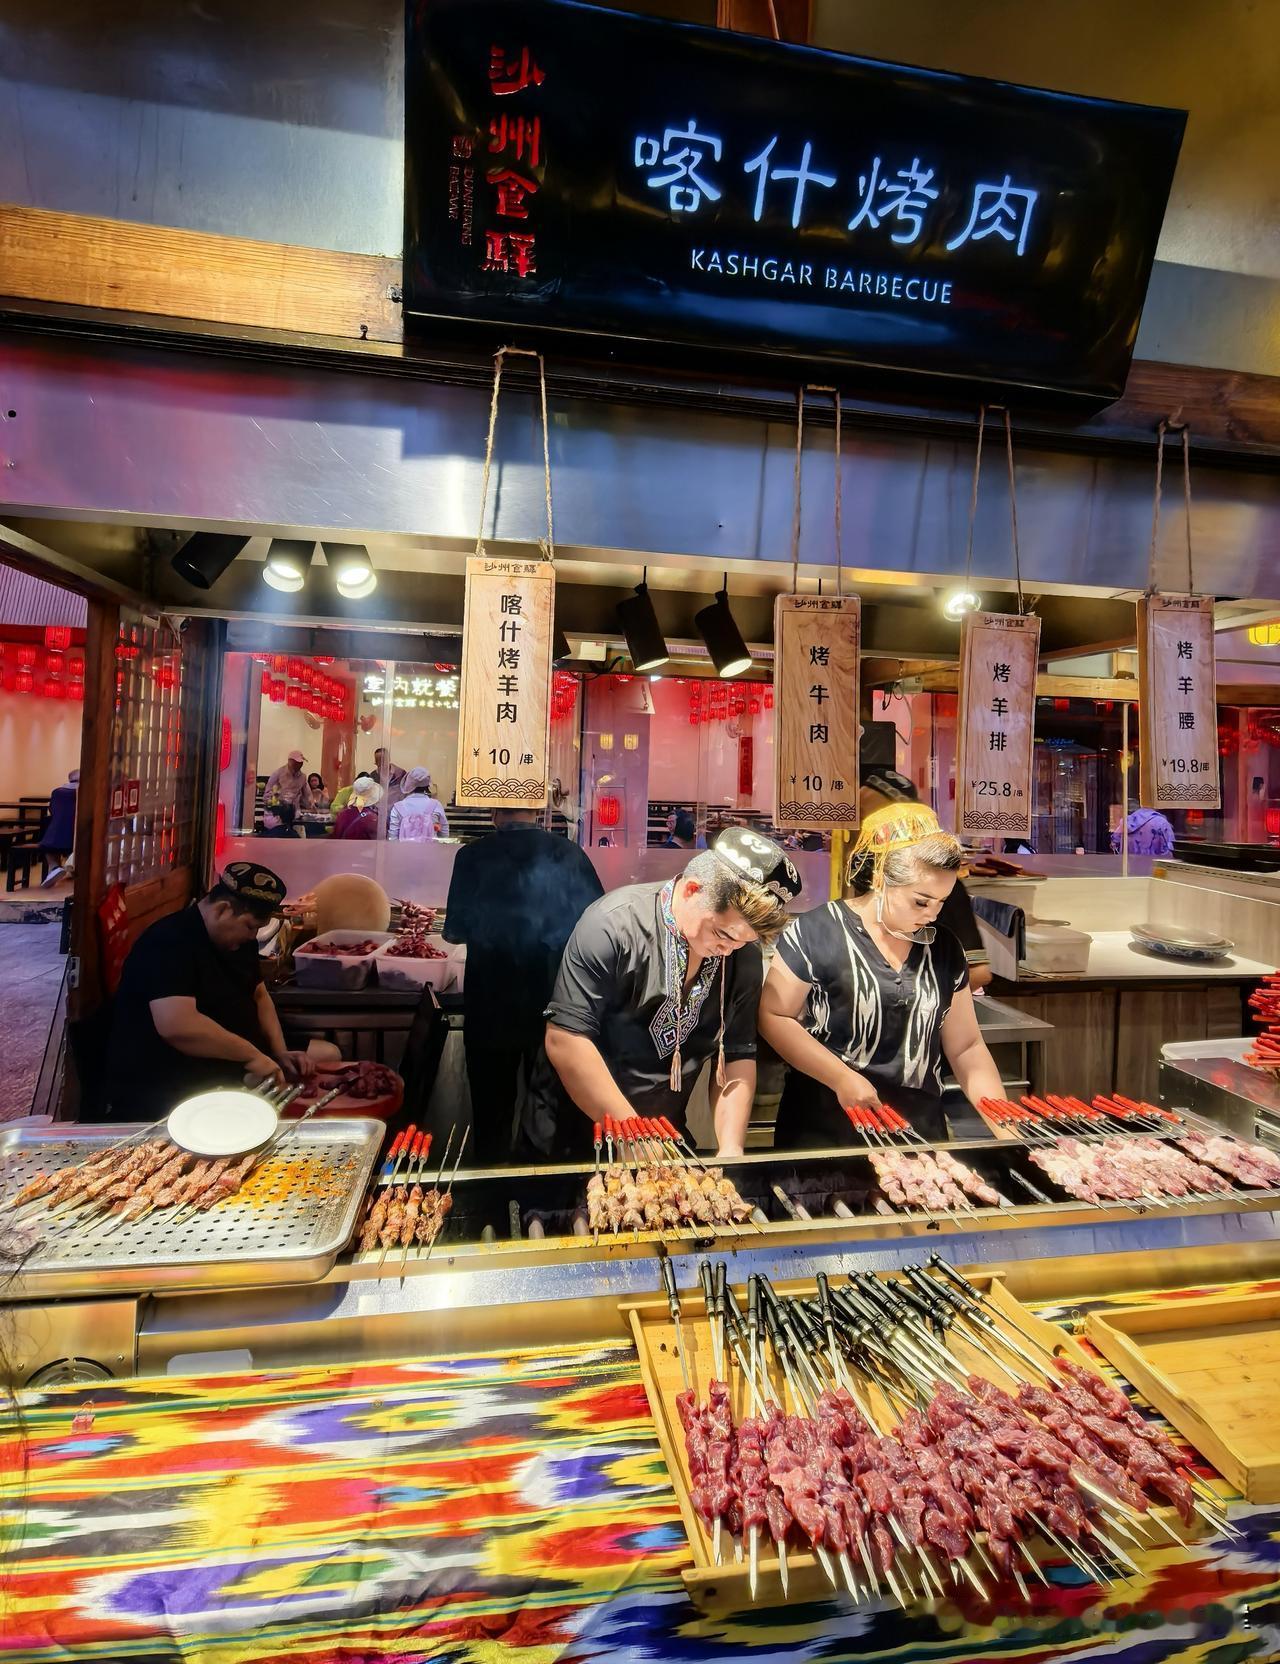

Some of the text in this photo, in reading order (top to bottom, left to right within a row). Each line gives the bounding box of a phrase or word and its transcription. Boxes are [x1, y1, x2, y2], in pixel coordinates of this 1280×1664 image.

[634, 119, 1039, 256] 喀什烤肉
[690, 248, 953, 305] KASHGAR BARBECUE
[496, 594, 522, 723] 喀什烤羊肉
[809, 646, 830, 744] 烤牛肉
[1177, 641, 1195, 730] 烤羊腰
[989, 663, 1011, 751] 烤羊排
[488, 748, 510, 765] 10
[802, 775, 822, 791] 10
